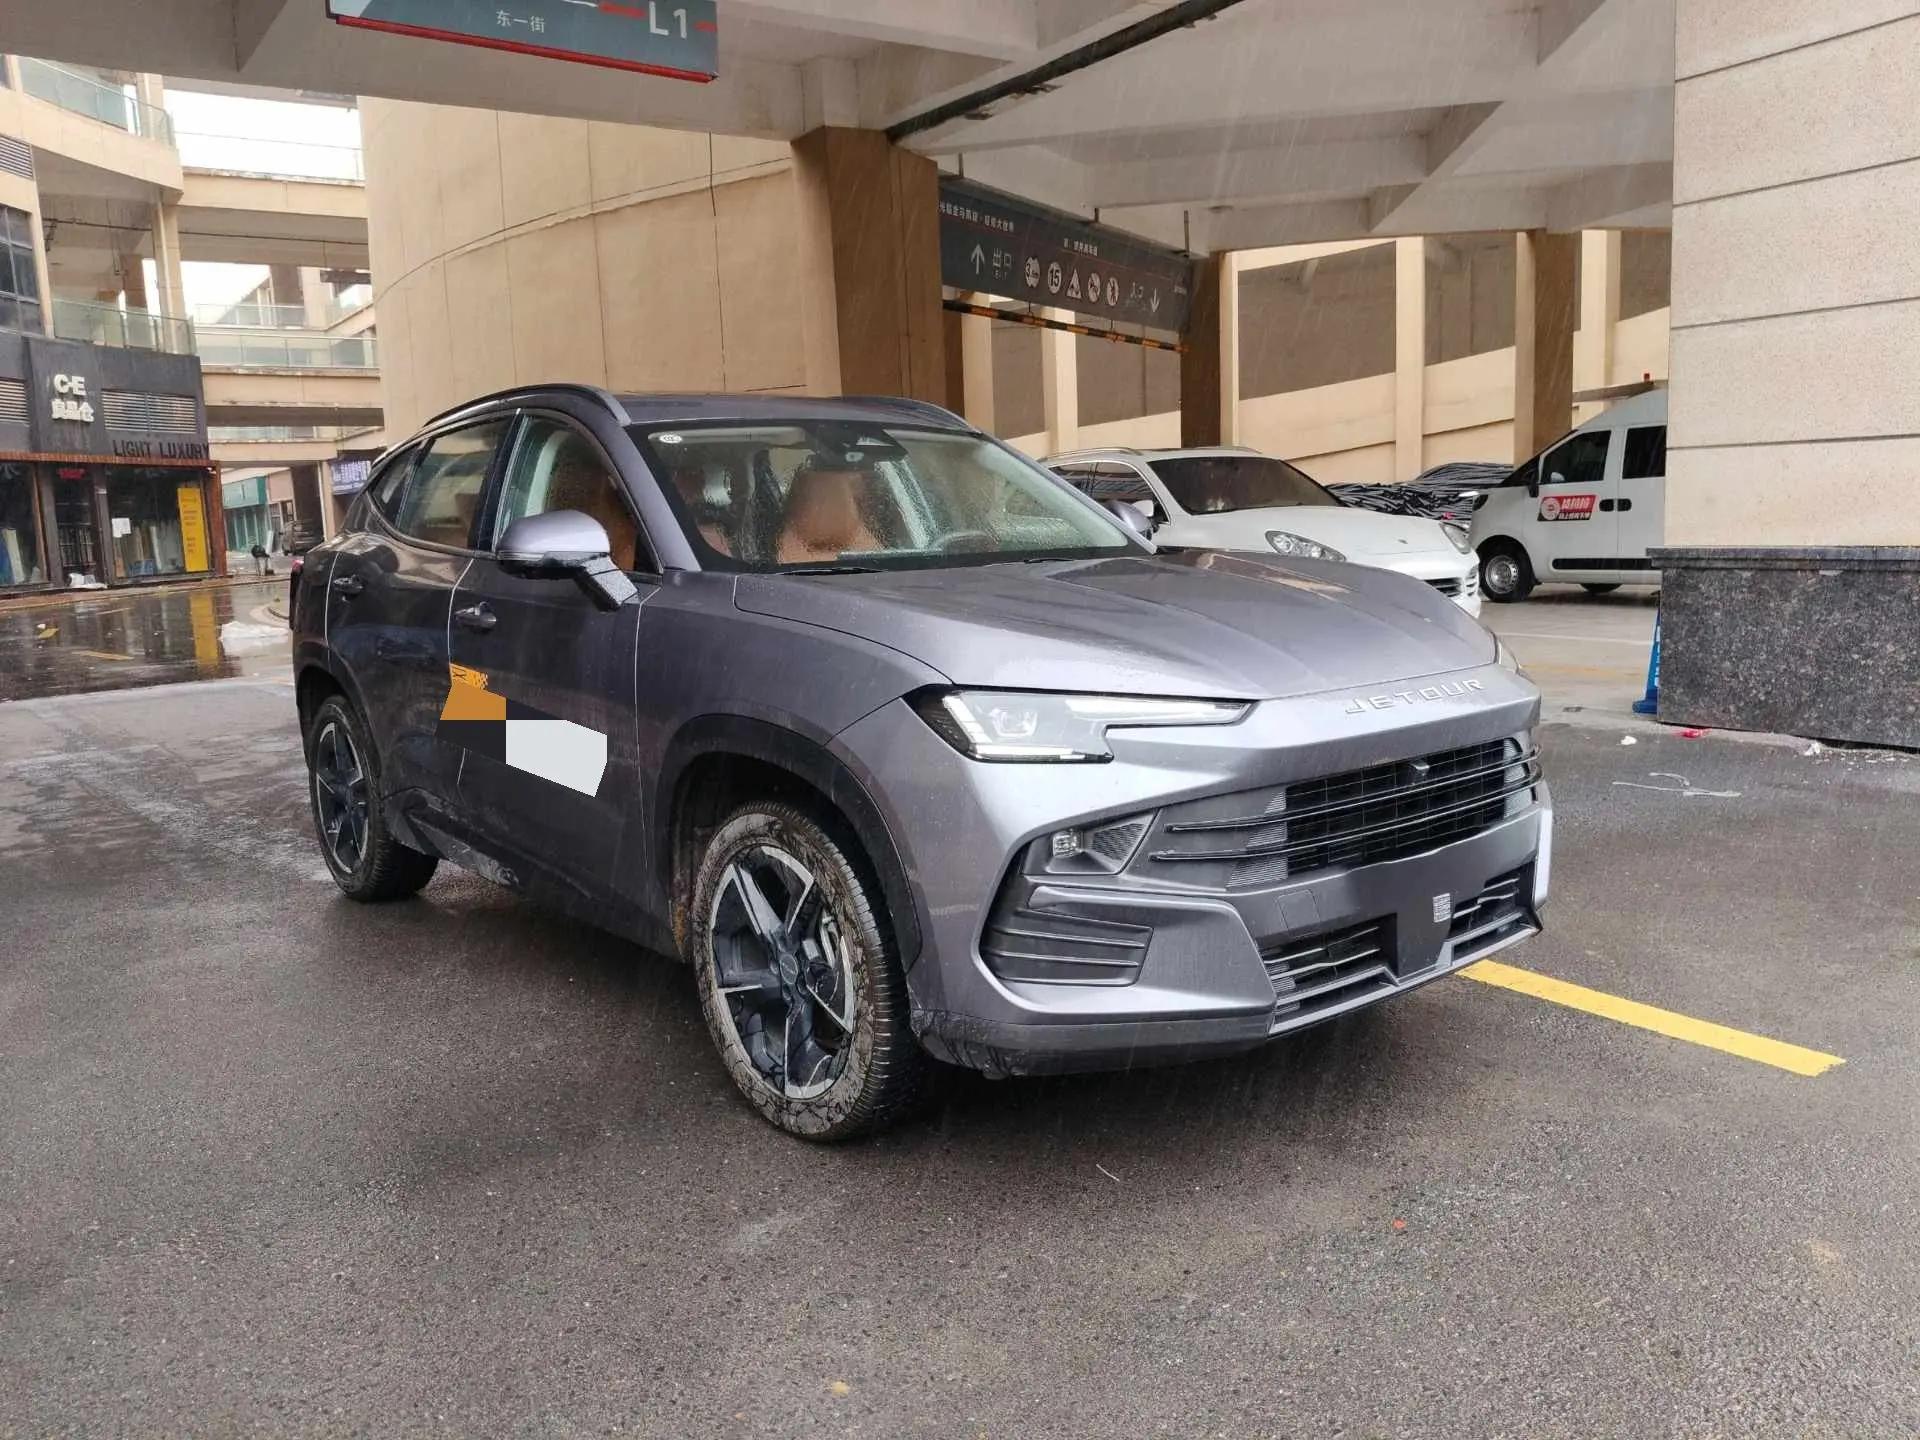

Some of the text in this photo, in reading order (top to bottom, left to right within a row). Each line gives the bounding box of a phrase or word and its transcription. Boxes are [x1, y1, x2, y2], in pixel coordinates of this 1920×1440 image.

[496, 9, 545, 33] 东一街
[649, 1, 687, 39] L1
[992, 247, 1012, 268] 出口
[1049, 267, 1060, 287] 15
[112, 439, 209, 460] LIGHT LUXURY
[1345, 679, 1485, 714] JETOUR
